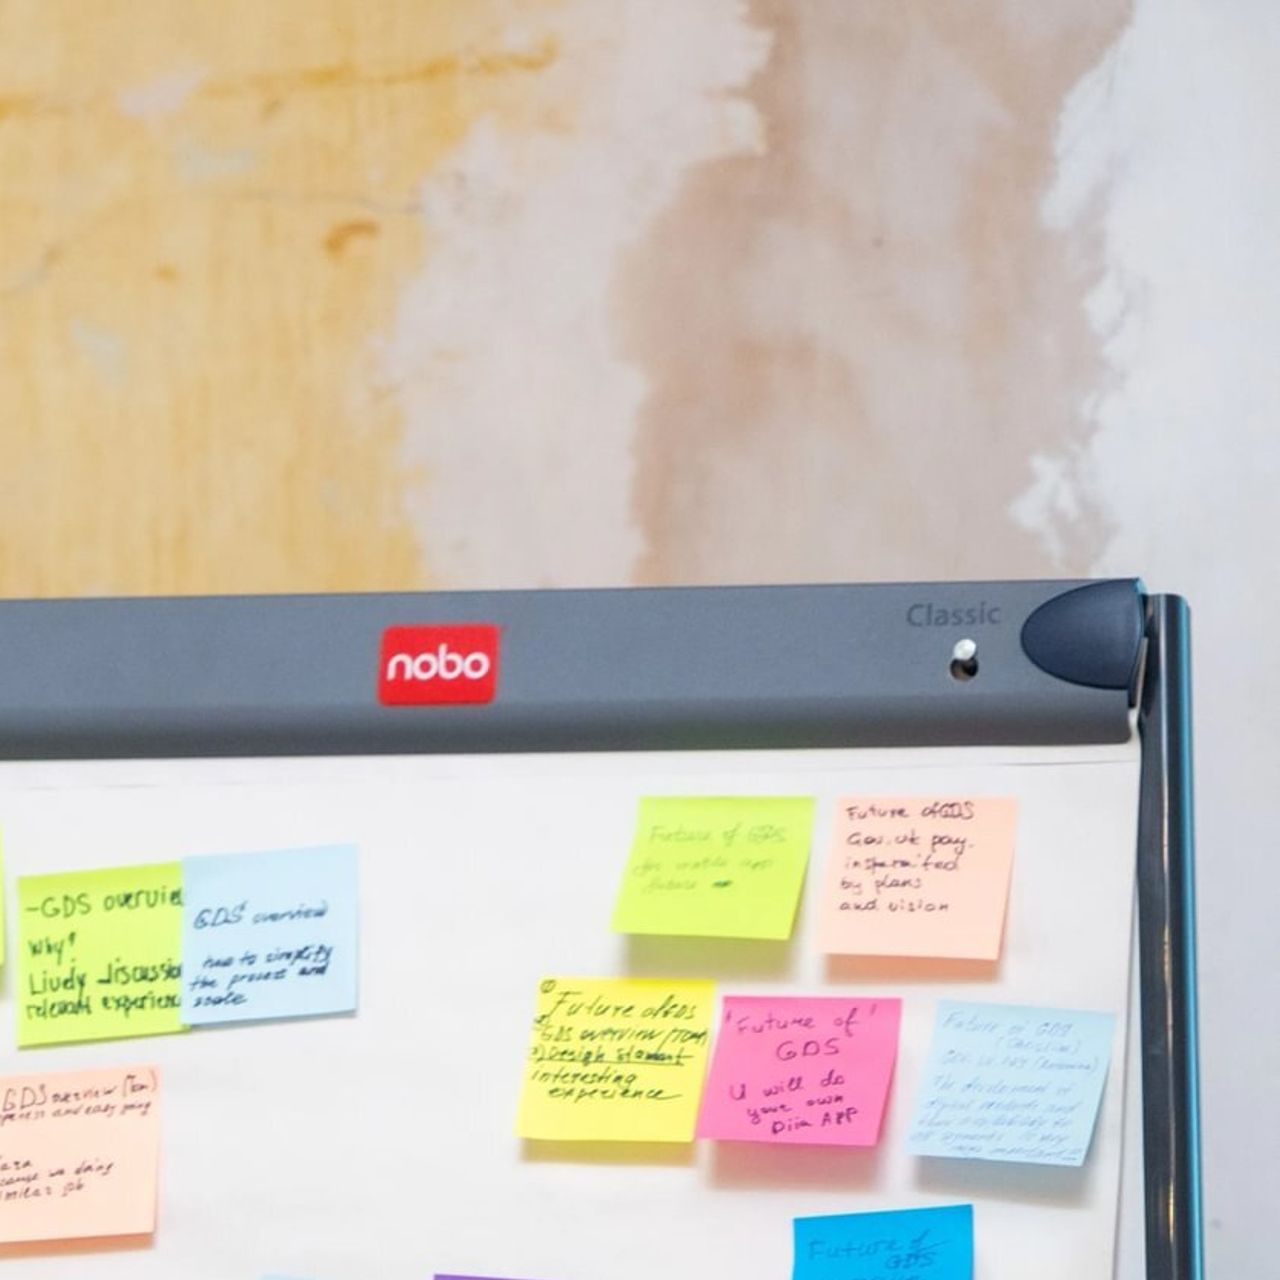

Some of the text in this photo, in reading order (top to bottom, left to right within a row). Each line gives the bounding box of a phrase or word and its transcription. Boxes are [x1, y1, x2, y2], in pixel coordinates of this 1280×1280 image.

[907, 601, 1001, 627] Classic
[386, 643, 490, 681] nobo
[846, 804, 910, 821] Future
[840, 878, 863, 895] by
[193, 900, 248, 929] GDS
[840, 899, 949, 913] and vision
[776, 1037, 840, 1061] GDS
[763, 1076, 804, 1097] will
[820, 1069, 846, 1087] do
[2, 1083, 47, 1112] GDS
[808, 1238, 904, 1260] Future
